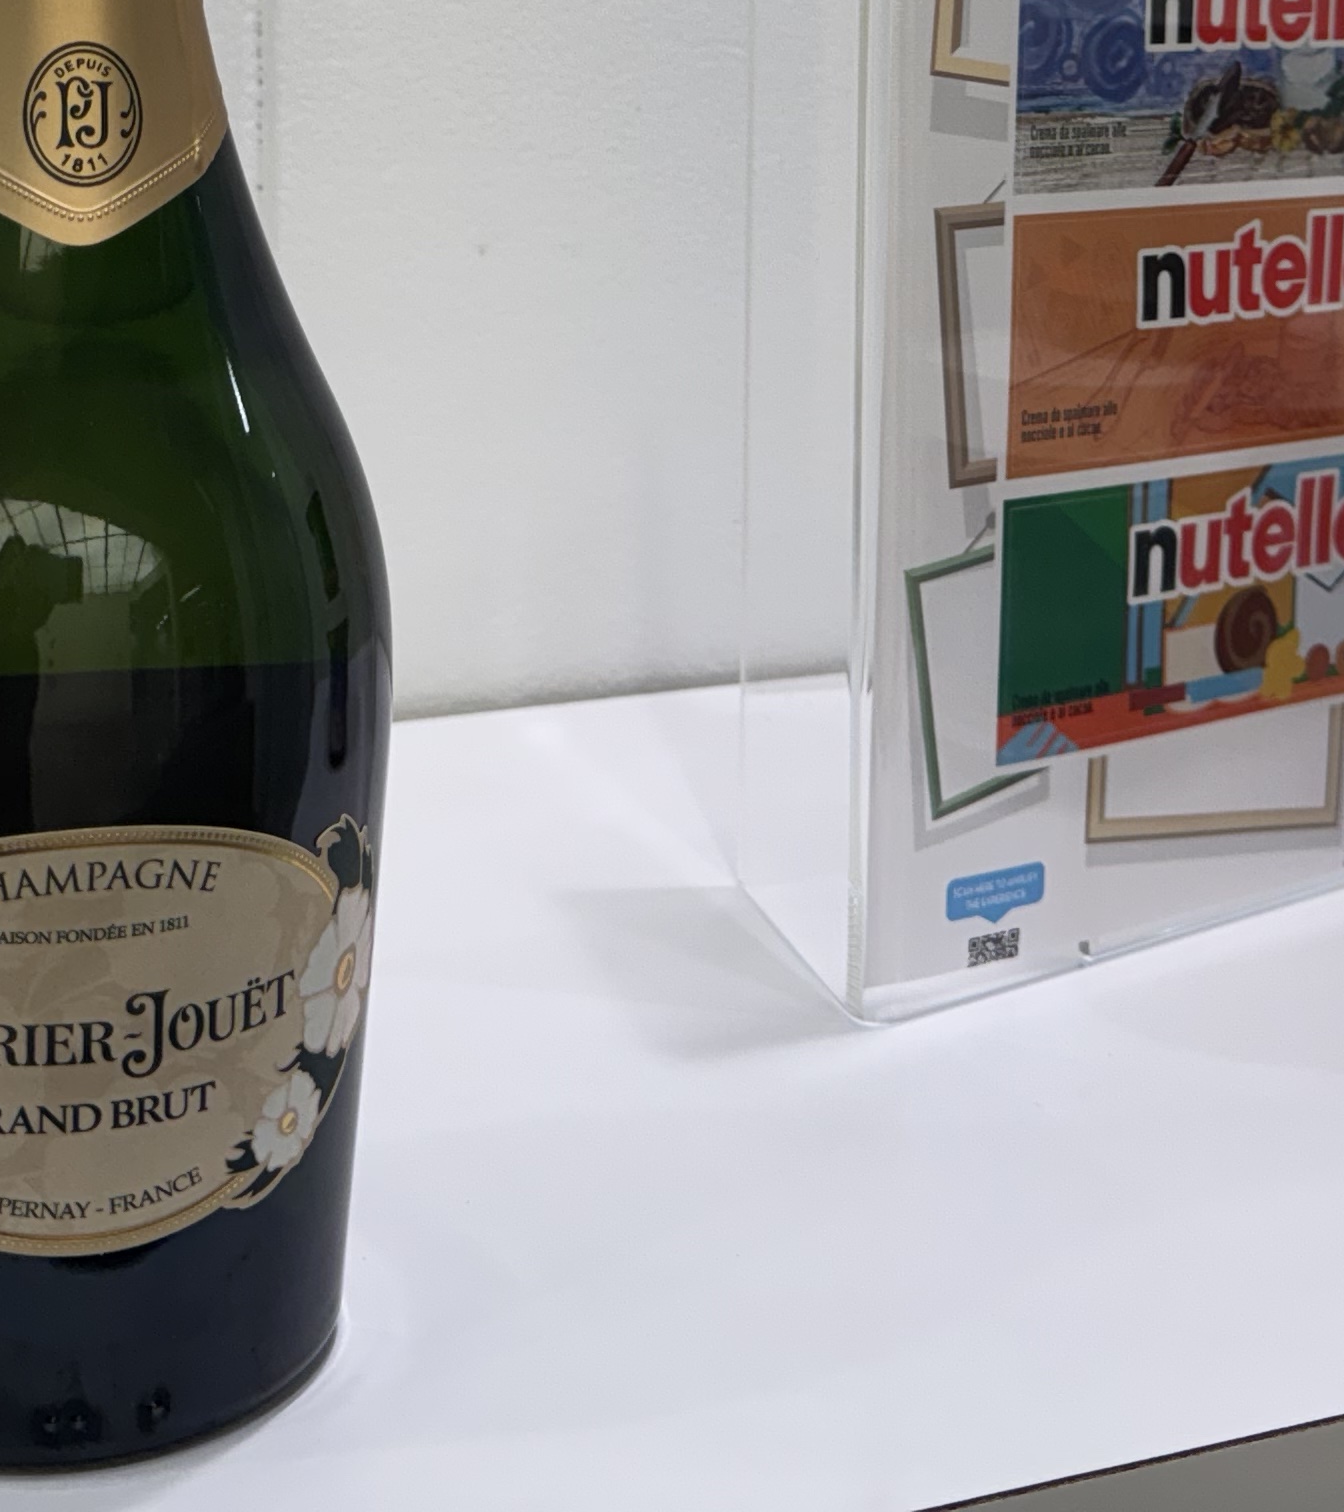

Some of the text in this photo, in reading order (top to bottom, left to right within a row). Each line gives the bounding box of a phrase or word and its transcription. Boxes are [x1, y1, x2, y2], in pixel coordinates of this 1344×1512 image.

[54, 57, 112, 79] DEPUIS
[61, 152, 109, 173] 1811
[57, 923, 128, 944] FONDÉE
[131, 921, 156, 936] EN
[159, 915, 190, 933] 1811
[111, 1080, 217, 1131] BRUT
[110, 1167, 204, 1216] FRANCE
